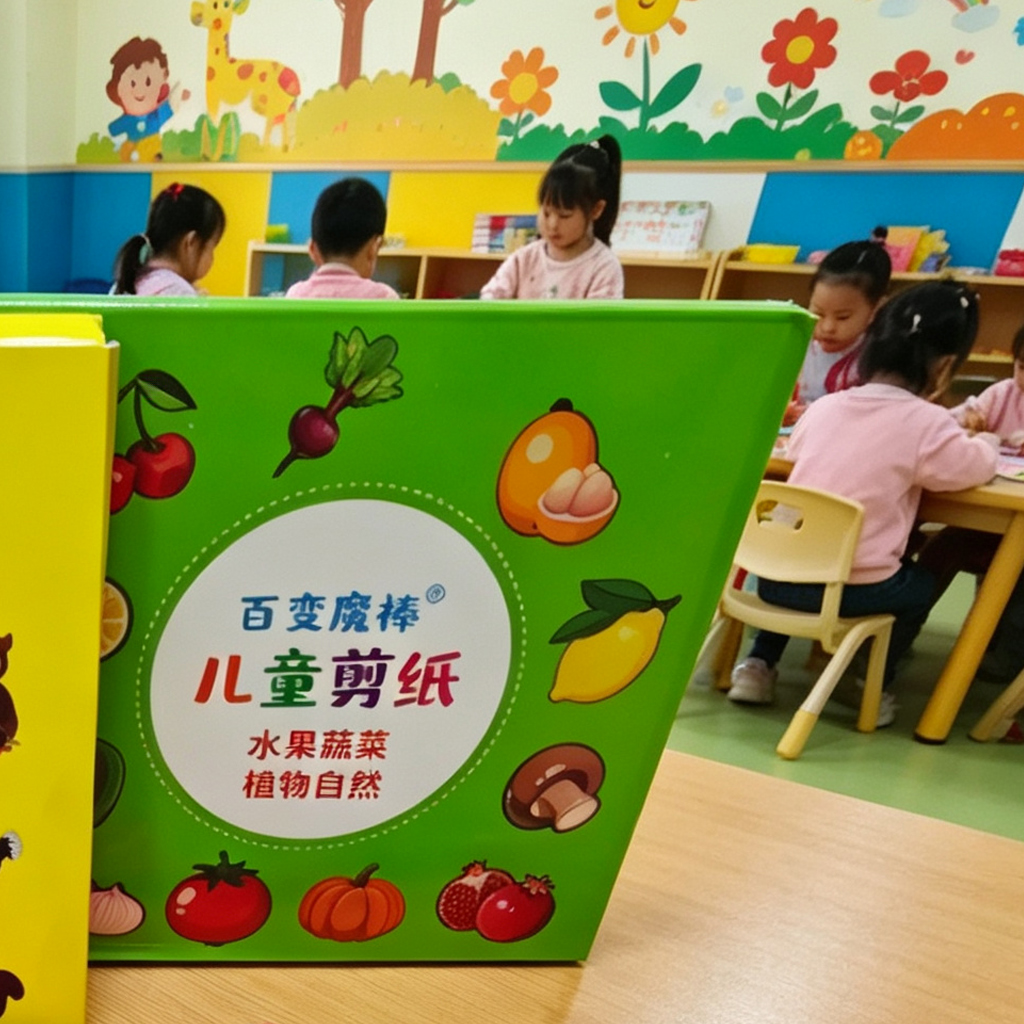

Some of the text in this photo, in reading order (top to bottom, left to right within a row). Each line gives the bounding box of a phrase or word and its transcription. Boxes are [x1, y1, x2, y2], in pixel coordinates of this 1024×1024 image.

[241, 590, 420, 633] 百变魔棒
[194, 647, 461, 708] 儿童剪纸
[247, 729, 390, 761] 水果蔬菜
[242, 770, 383, 800] 植物自然
